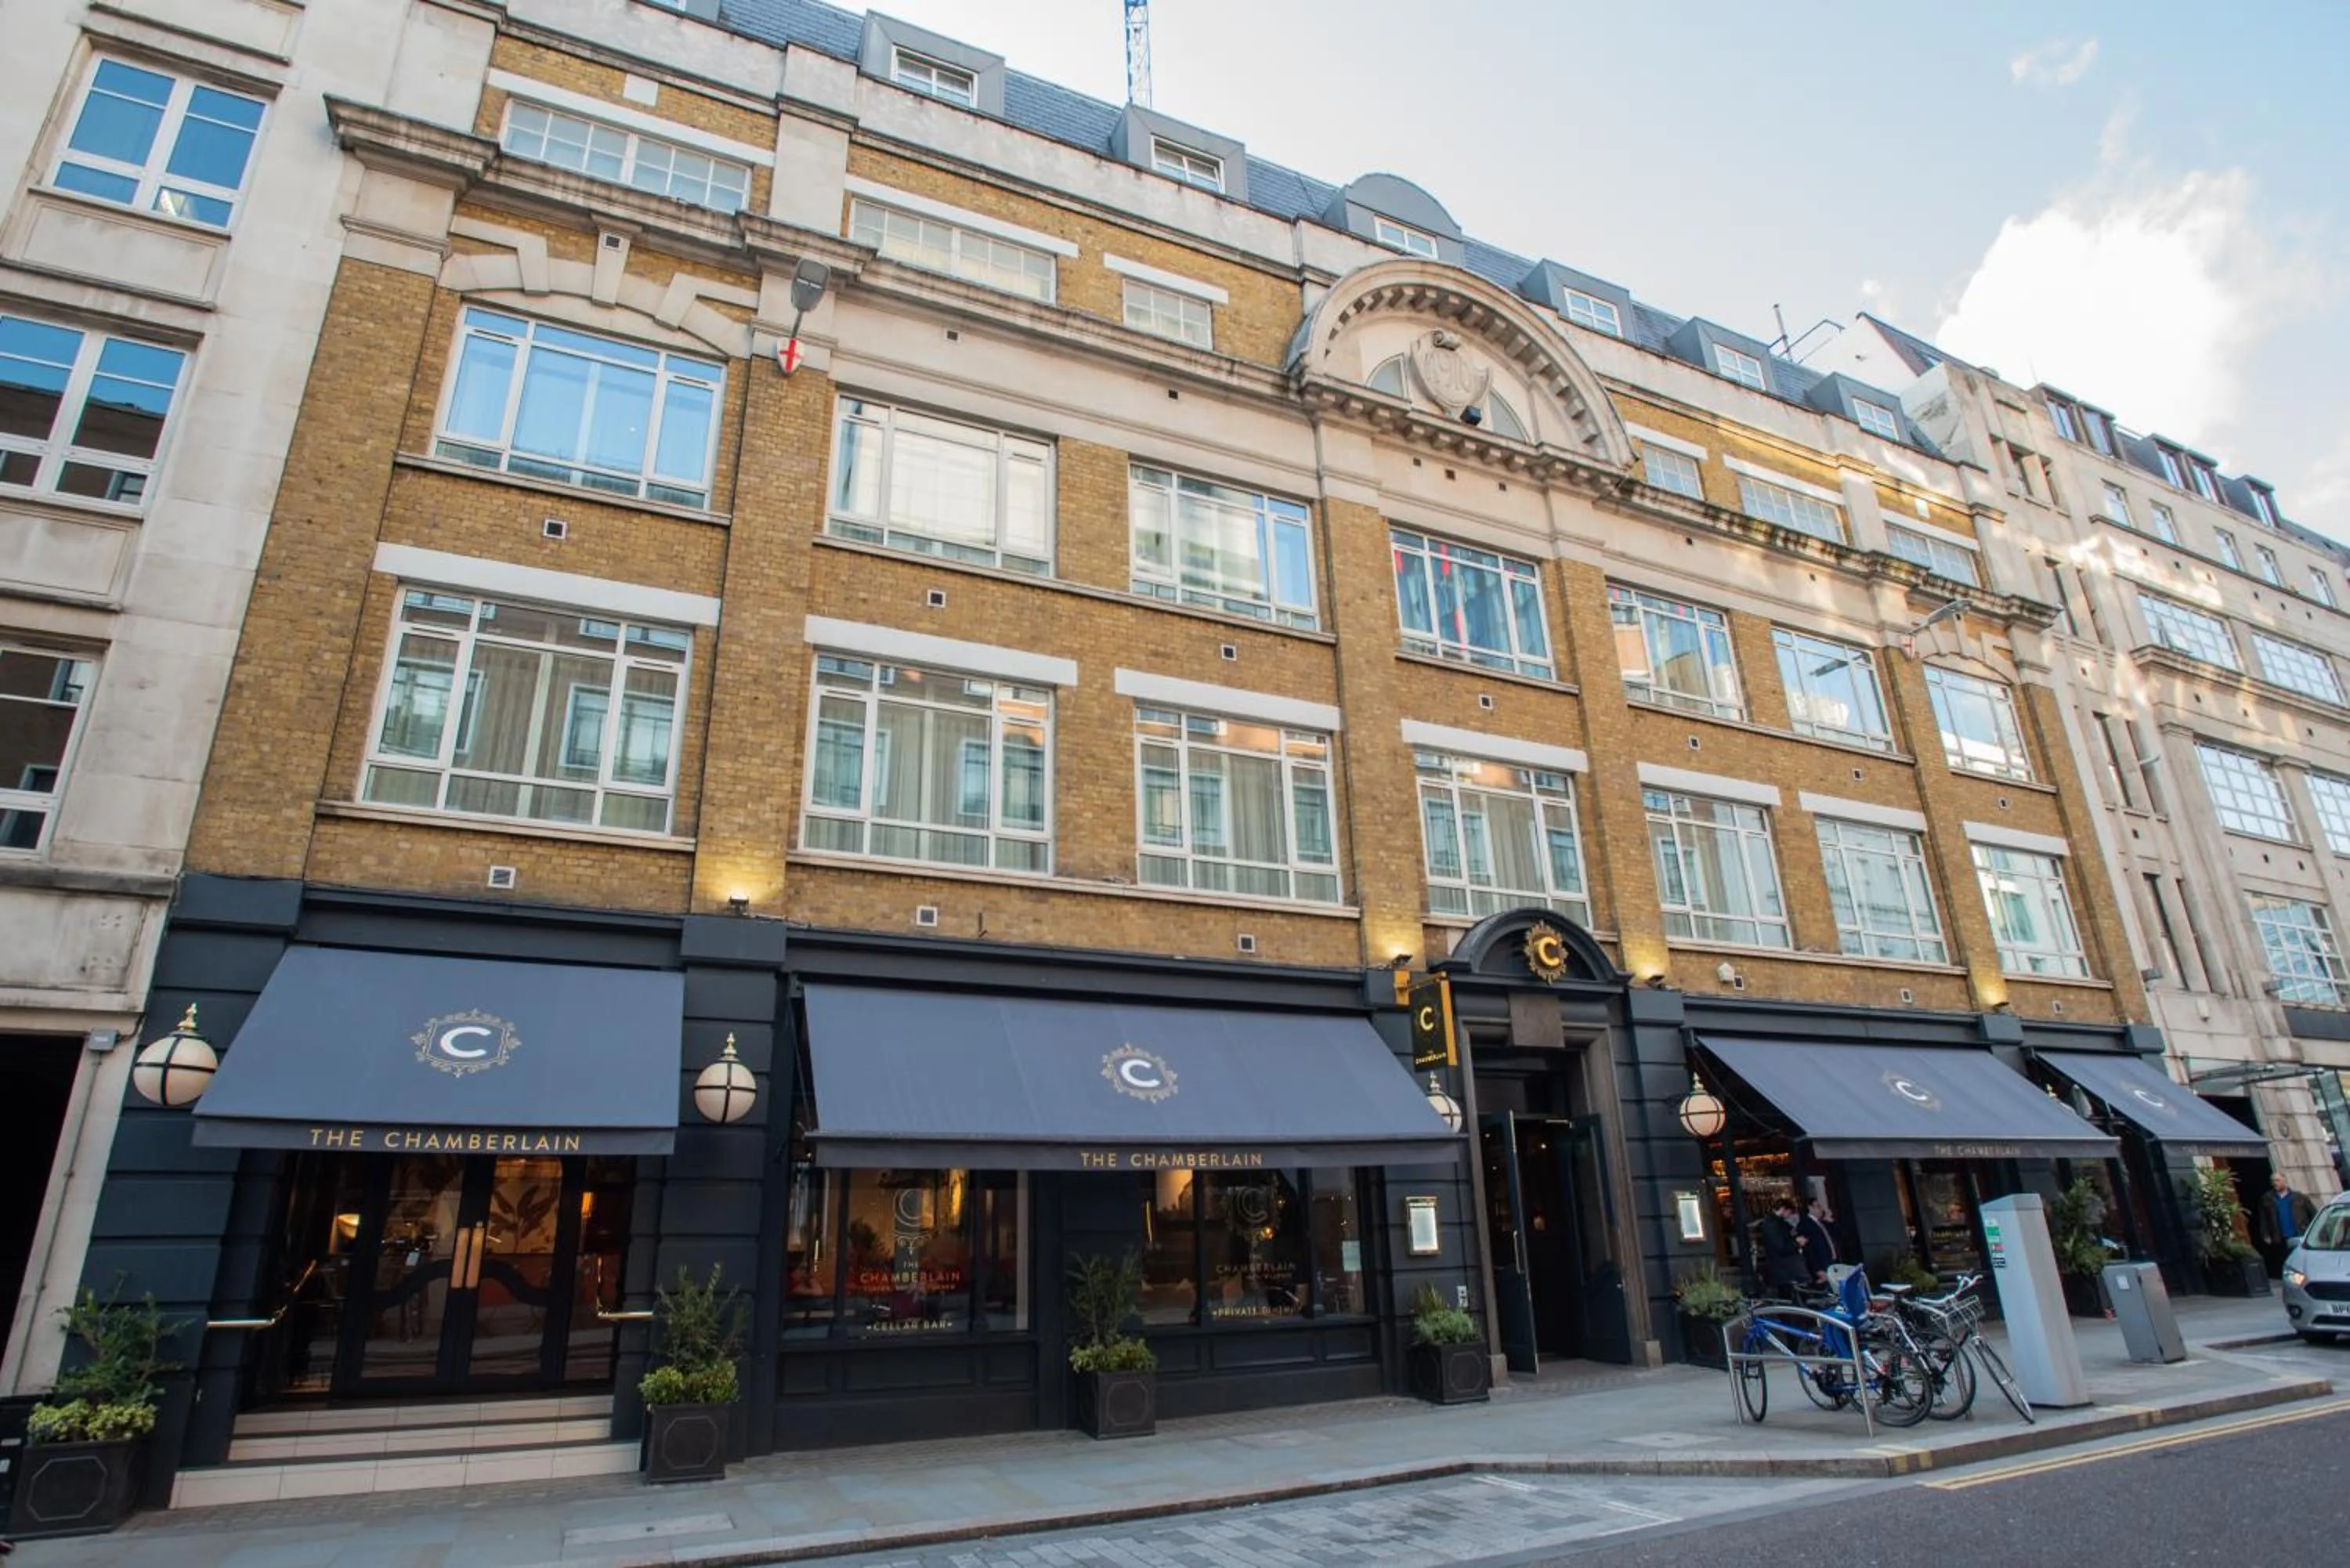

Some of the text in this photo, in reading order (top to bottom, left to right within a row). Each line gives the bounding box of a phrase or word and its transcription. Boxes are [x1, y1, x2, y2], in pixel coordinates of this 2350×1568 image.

[1538, 937, 1560, 967] C
[1420, 1006, 1434, 1031] C
[440, 1026, 492, 1058] C
[1120, 1059, 1160, 1087] C
[1896, 1081, 1928, 1100] C
[310, 1129, 580, 1151] THE CHAMBERLAIN
[1932, 1144, 1954, 1156] THE
[1080, 1152, 1263, 1168] THE CHAMBERLAIN
[1216, 1262, 1297, 1274] CHAMBERLAIN
[860, 1271, 960, 1284] CHAMBERLAIN
[1218, 1306, 1258, 1317] PRIVATE
[873, 1319, 946, 1331] CELLAR BAR
